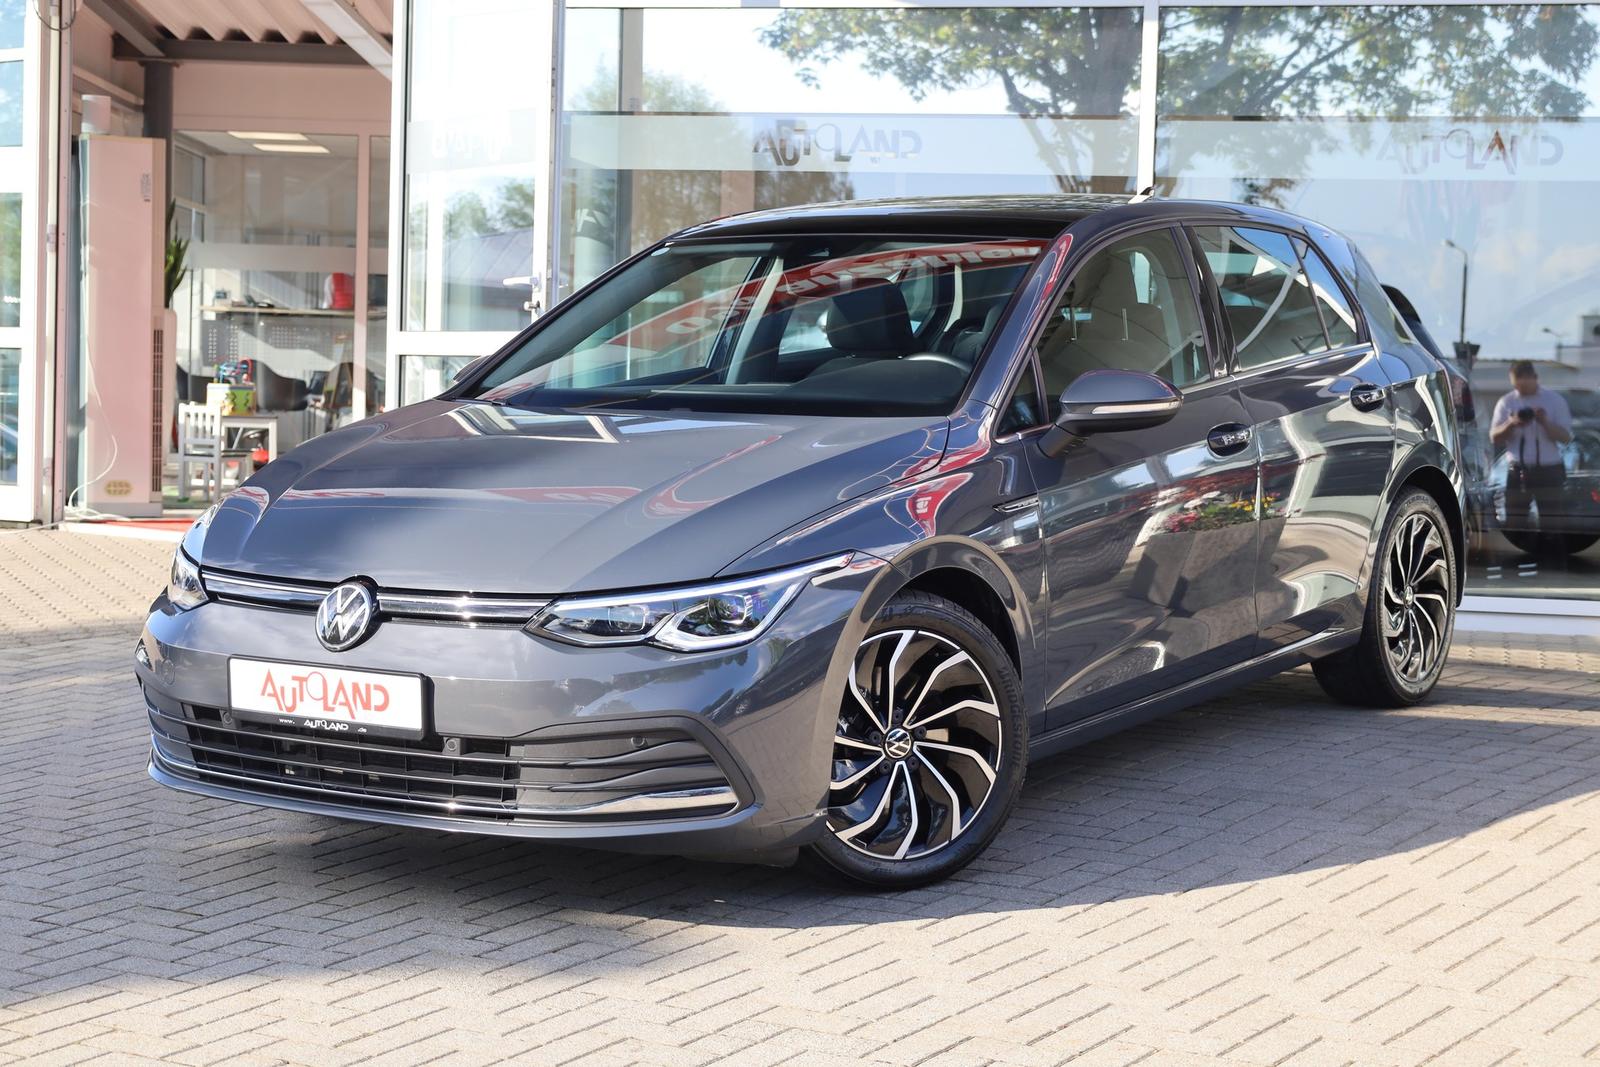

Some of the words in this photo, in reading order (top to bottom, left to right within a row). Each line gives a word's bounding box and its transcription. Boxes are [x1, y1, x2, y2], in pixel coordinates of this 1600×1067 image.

[752, 123, 922, 167] AUTOLAND
[1376, 127, 1565, 176] AUTOLAND
[318, 585, 369, 645] VW
[261, 668, 390, 720] AUTOLAND
[303, 719, 349, 731] AUTOLAND
